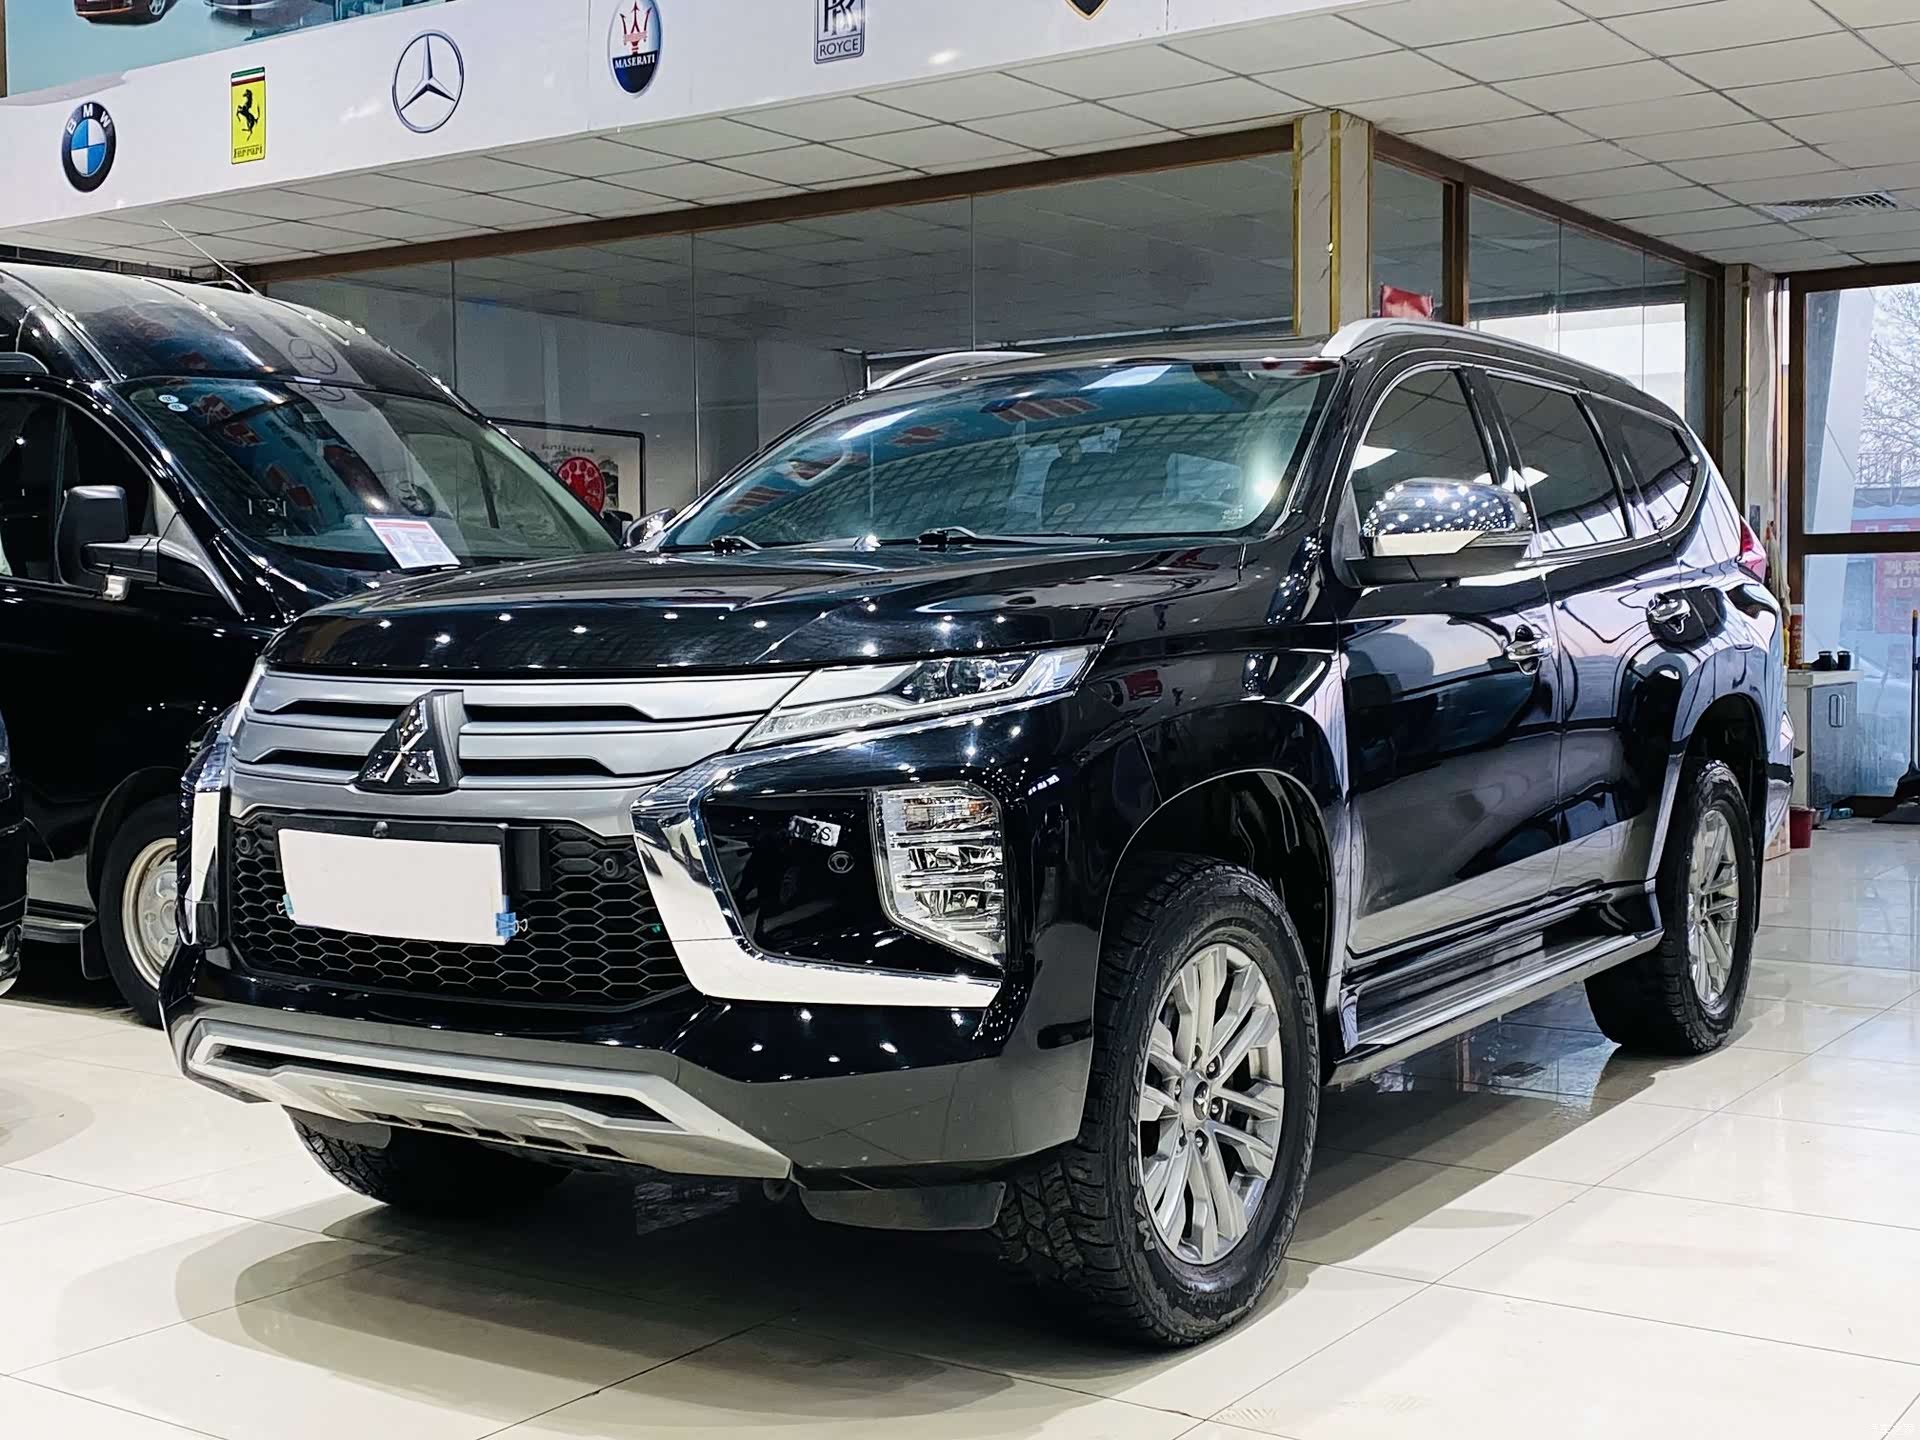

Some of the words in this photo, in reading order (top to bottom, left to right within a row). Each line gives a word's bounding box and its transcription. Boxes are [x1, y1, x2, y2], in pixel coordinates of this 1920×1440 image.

[819, 38, 859, 56] ROYCE
[614, 53, 656, 69] MASERATI
[66, 103, 111, 135] BMW
[233, 144, 263, 159] Ferrari
